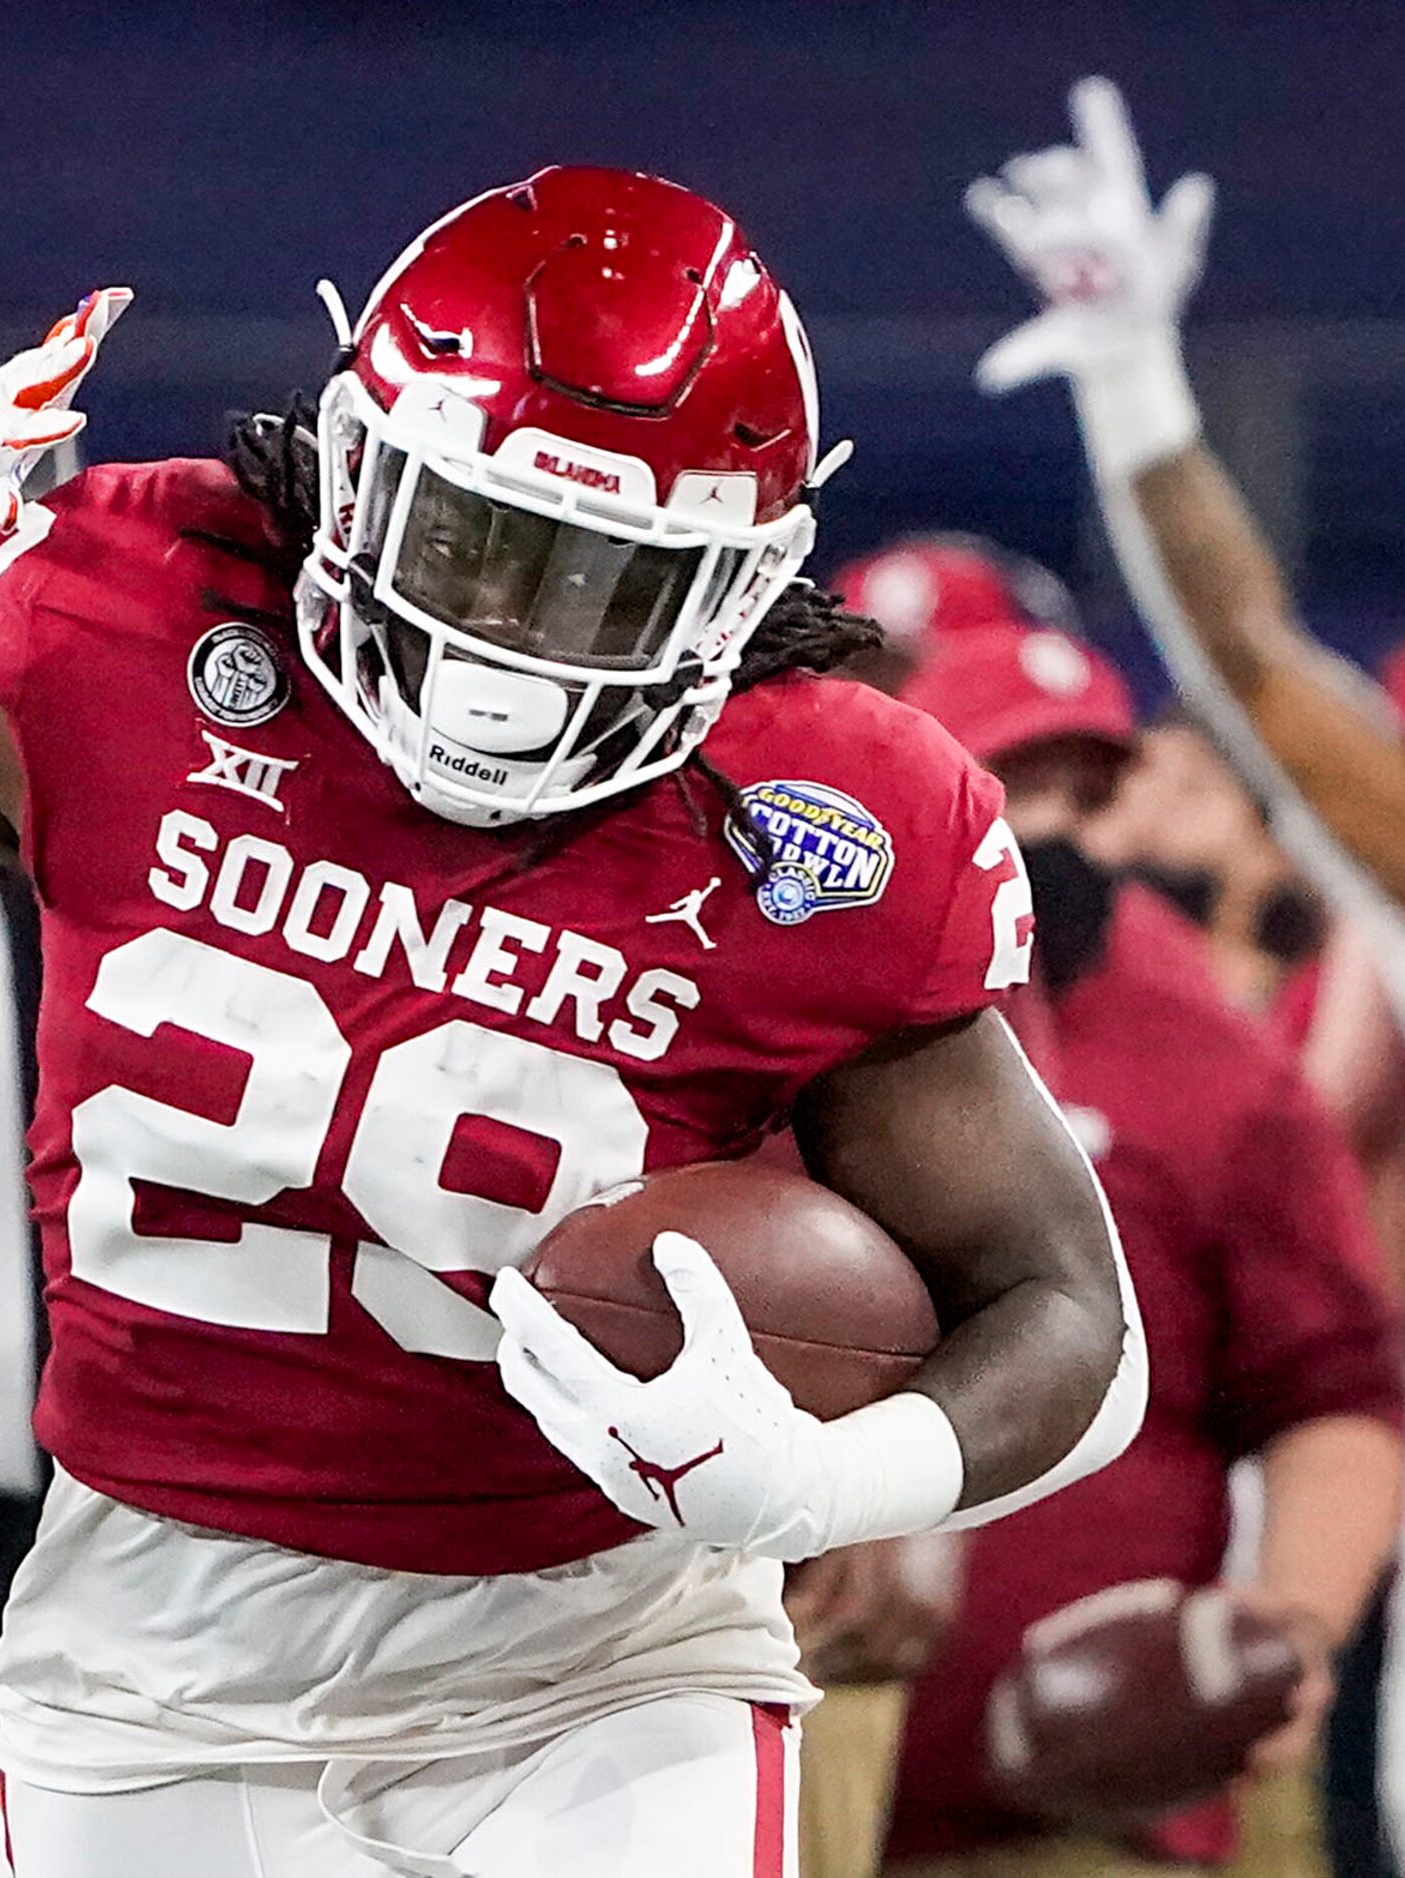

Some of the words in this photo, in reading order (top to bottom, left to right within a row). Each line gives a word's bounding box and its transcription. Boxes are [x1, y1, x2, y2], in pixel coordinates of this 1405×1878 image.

[429, 744, 508, 786] Riddell
[758, 789, 884, 848] GOODYEAR
[147, 808, 701, 1062] SOONERS
[68, 926, 650, 1363] 29
